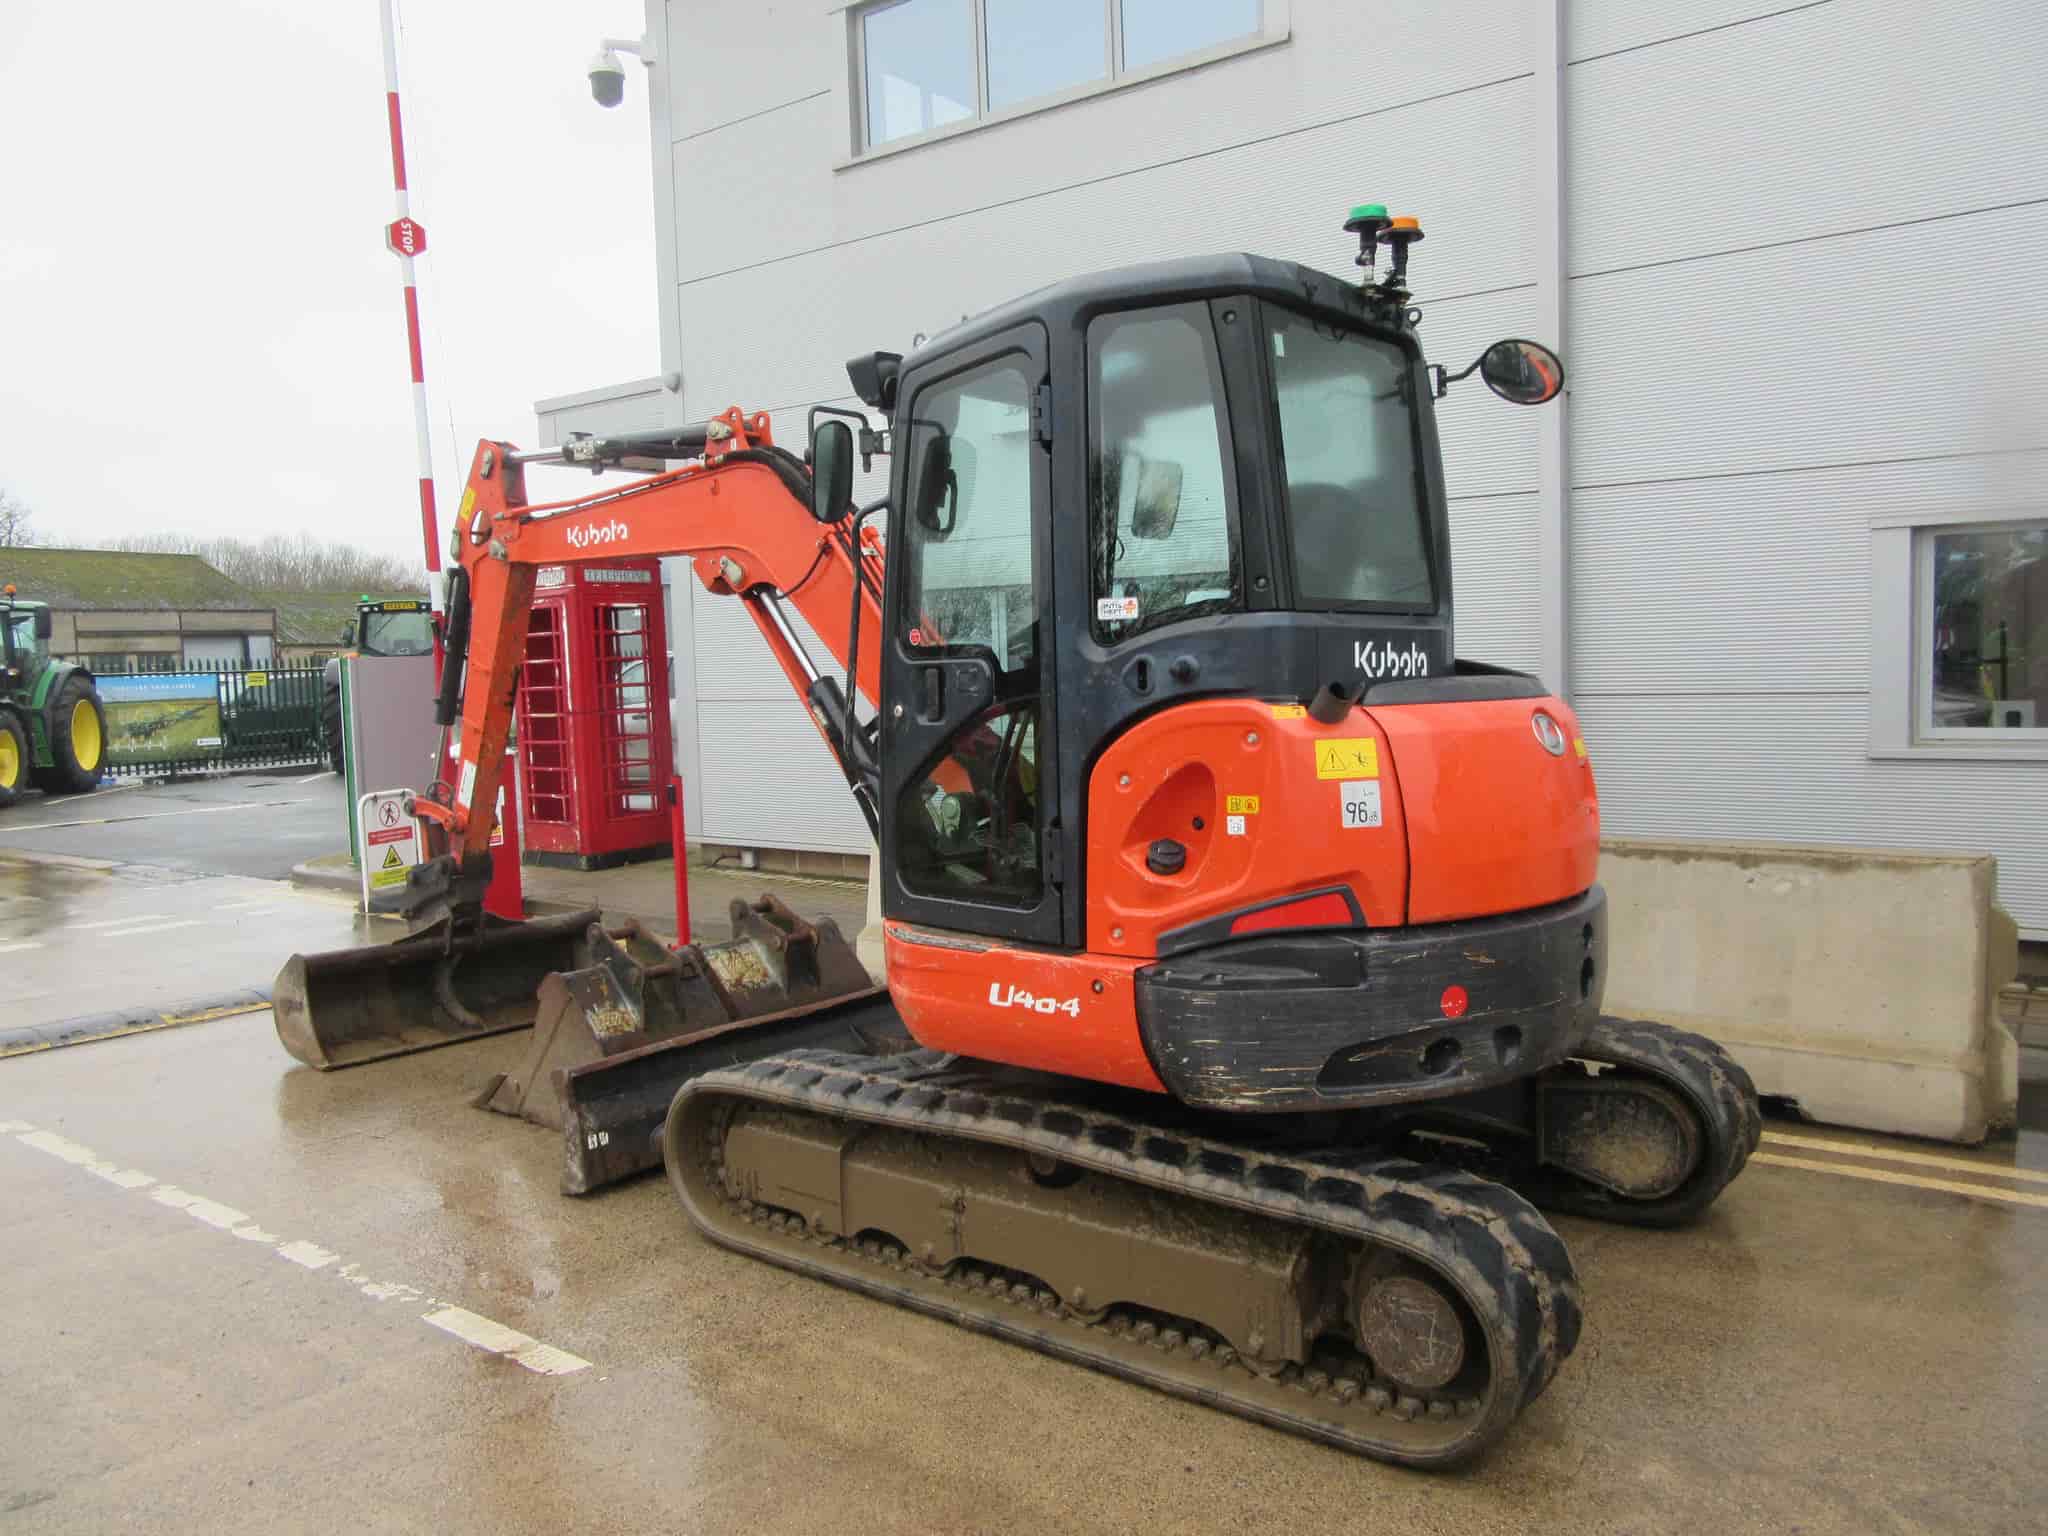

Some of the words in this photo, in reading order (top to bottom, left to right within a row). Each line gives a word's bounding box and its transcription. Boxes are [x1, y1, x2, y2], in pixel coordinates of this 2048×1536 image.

[401, 221, 414, 253] STOP
[566, 519, 629, 548] Kubota
[1354, 640, 1428, 678] Kubota
[1345, 801, 1368, 824] 96
